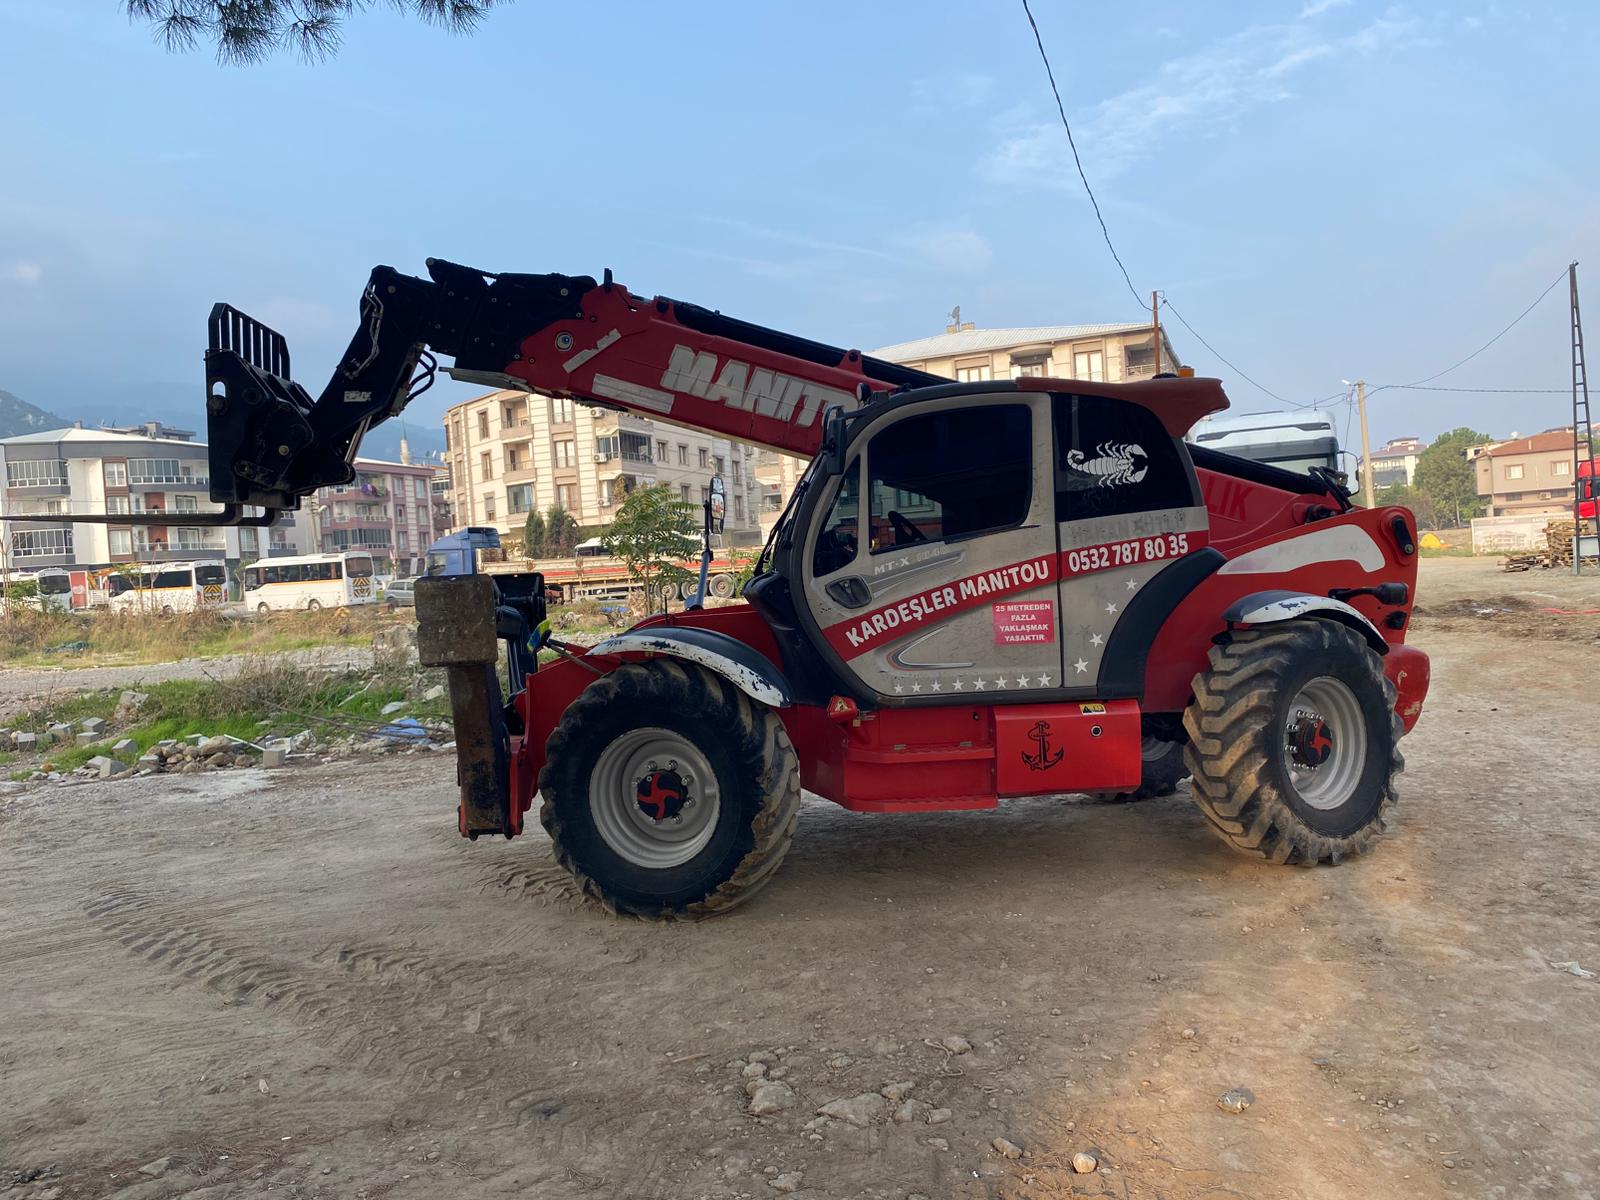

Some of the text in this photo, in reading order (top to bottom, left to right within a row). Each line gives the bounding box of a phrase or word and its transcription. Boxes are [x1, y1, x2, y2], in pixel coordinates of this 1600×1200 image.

[1068, 533, 1189, 572] 0532 787 80 35
[1007, 604, 1051, 612] METREDEN
[845, 586, 956, 648] KARDEŞLER
[1010, 614, 1036, 622] FAZLA
[999, 624, 1049, 633] YAKLAŞMAK
[1004, 633, 1045, 642] YASAKTIR
